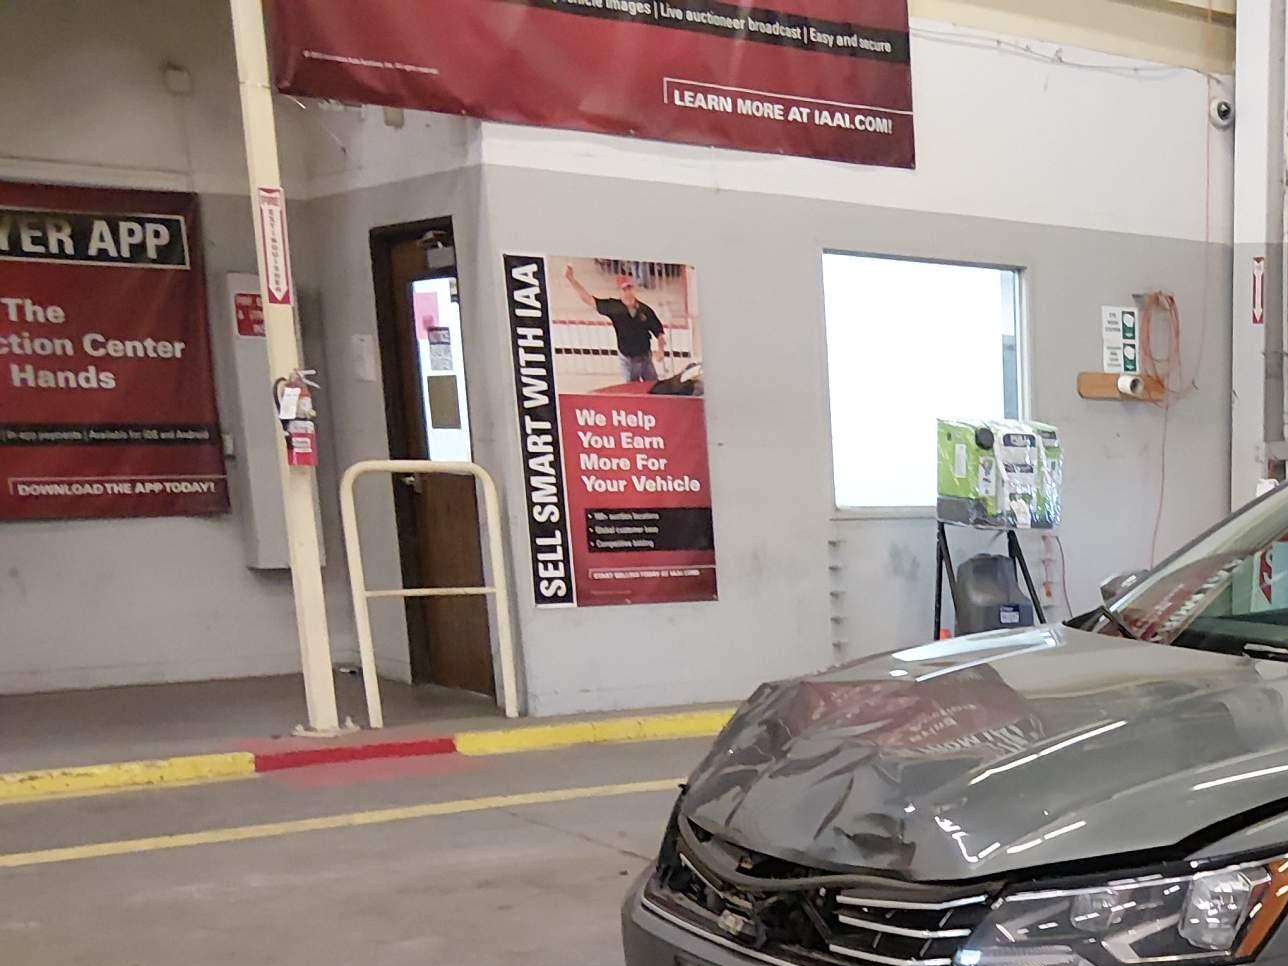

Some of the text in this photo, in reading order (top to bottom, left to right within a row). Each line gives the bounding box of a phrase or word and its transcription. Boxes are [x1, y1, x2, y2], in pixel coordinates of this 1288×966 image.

[605, 0, 651, 16] images
[660, 3, 683, 20] Live
[686, 10, 746, 30] auctioneer
[748, 16, 802, 40] broadcast
[809, 28, 834, 48] Easy
[836, 33, 858, 48] and
[859, 38, 892, 53] secure
[674, 89, 893, 134] LEARN MORE AT IAAI.COM!
[88, 220, 170, 260] APP
[3, 298, 66, 324] The
[82, 333, 186, 358] Center
[10, 364, 117, 389] Hands
[511, 262, 567, 599] SELL SMART WITH IAA
[575, 409, 656, 430] We Help
[577, 431, 664, 449] You Earn
[580, 454, 667, 471] More For
[17, 481, 215, 496] DOWNLOAD THE APP TODAY!
[581, 475, 701, 492] Your Vehicle
